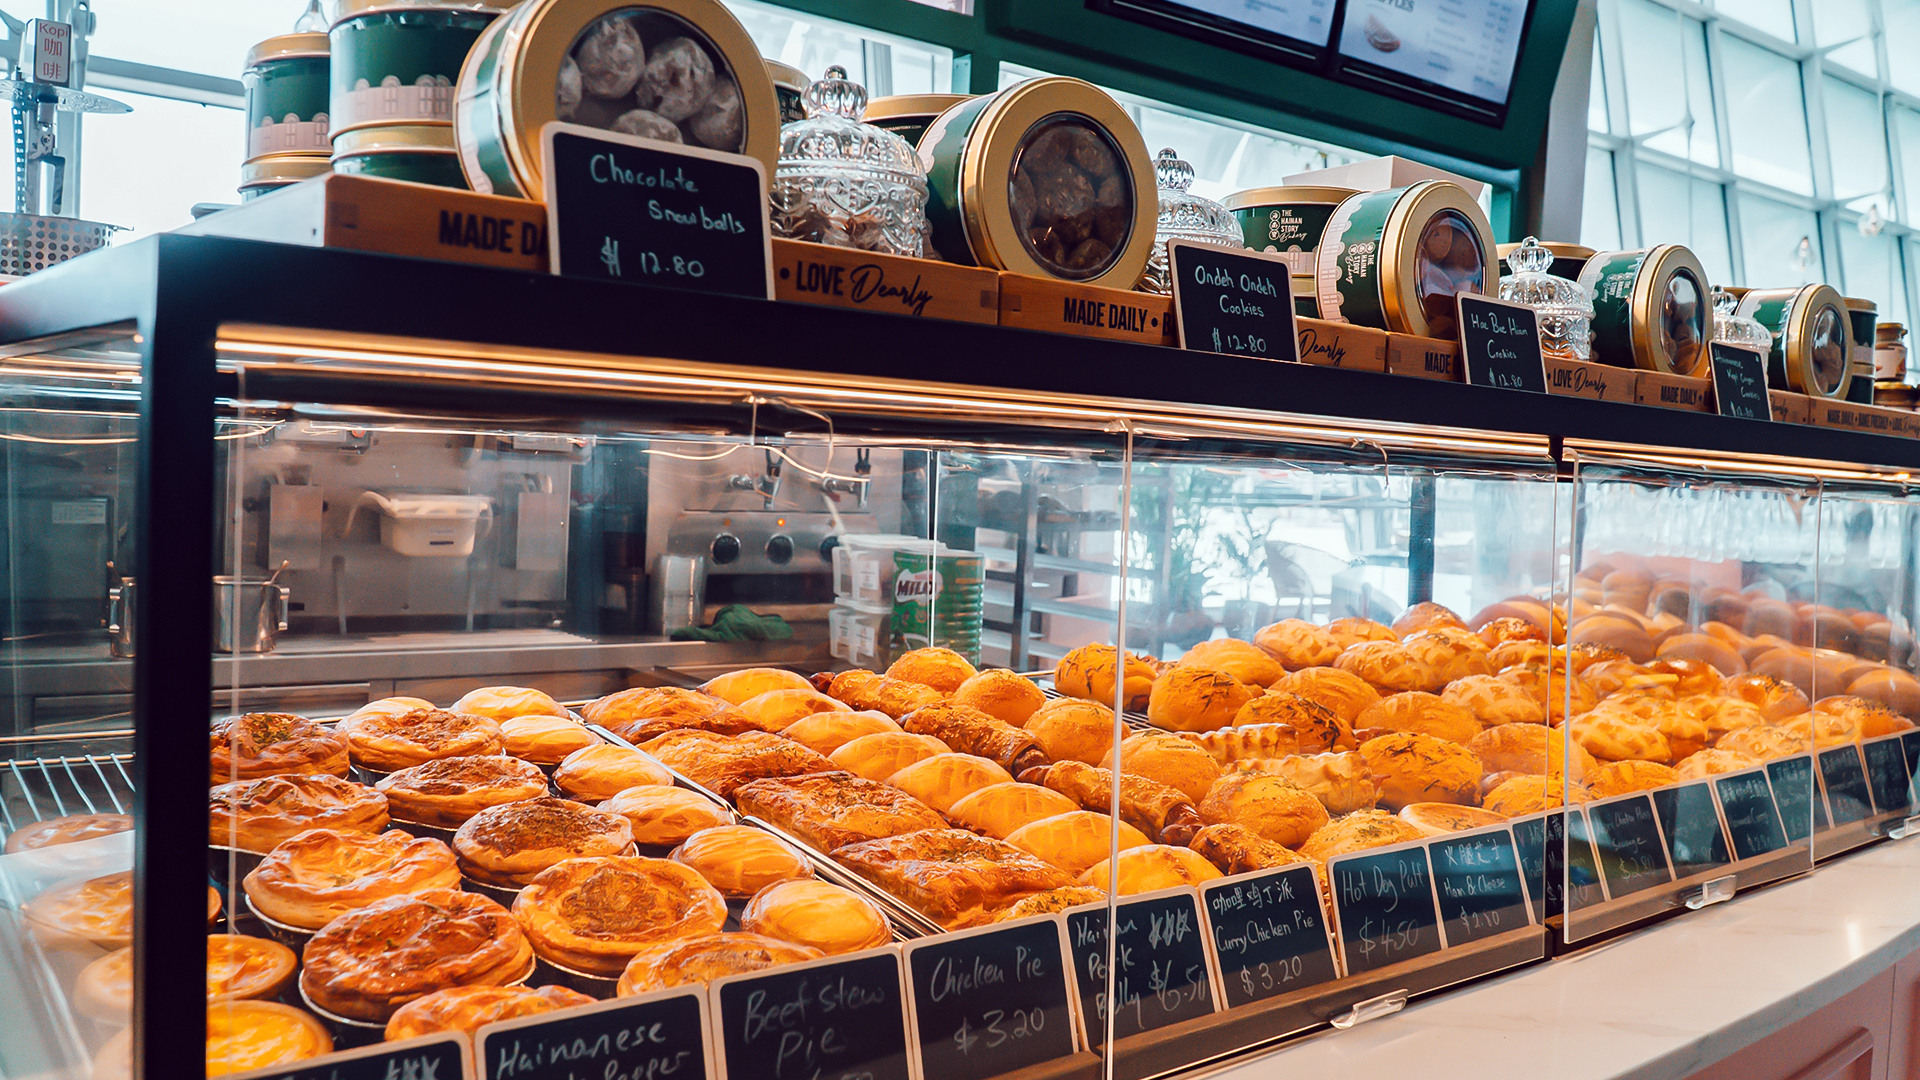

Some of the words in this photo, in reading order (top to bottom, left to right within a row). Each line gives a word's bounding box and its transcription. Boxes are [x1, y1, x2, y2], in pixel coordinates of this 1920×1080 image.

[39, 22, 68, 38] Kopi
[43, 38, 63, 80] 咖啡
[590, 153, 699, 193] Chocolate
[438, 208, 515, 254] MADE
[1280, 217, 1303, 225] HAINAN
[1280, 225, 1299, 233] STORY
[1281, 209, 1293, 217] THE
[640, 251, 705, 278] 12.80
[1367, 253, 1375, 266] THE
[795, 260, 846, 297] LOVE
[849, 263, 934, 318] Dearly
[1195, 264, 1235, 289] Ondeh
[1240, 273, 1277, 298] Ondeh
[1063, 296, 1106, 328] MADE
[1108, 303, 1149, 334] DAILY
[1219, 294, 1265, 318] Cookies
[1298, 328, 1347, 367] Dearly
[1424, 351, 1451, 375] MADE
[1486, 338, 1518, 359] Cookies
[1553, 367, 1572, 389] LOVE
[1573, 366, 1607, 400] Dearly
[1660, 385, 1679, 404] MADE
[1679, 387, 1697, 406] DAILY
[1341, 869, 1368, 907] Hot
[1373, 864, 1399, 913] Dog
[1477, 873, 1507, 894] Cheese
[1216, 925, 1248, 955] Curry
[1246, 916, 1292, 945] Chicken
[1293, 909, 1315, 931] Pie
[930, 955, 1005, 1002] Chicken
[1016, 945, 1046, 983] Pie
[1088, 943, 1135, 982] Pok
[743, 980, 812, 1045] Beef
[1095, 976, 1146, 1030] Blly
[496, 1020, 667, 1080] Hainanese
[776, 1027, 847, 1080] Pie
